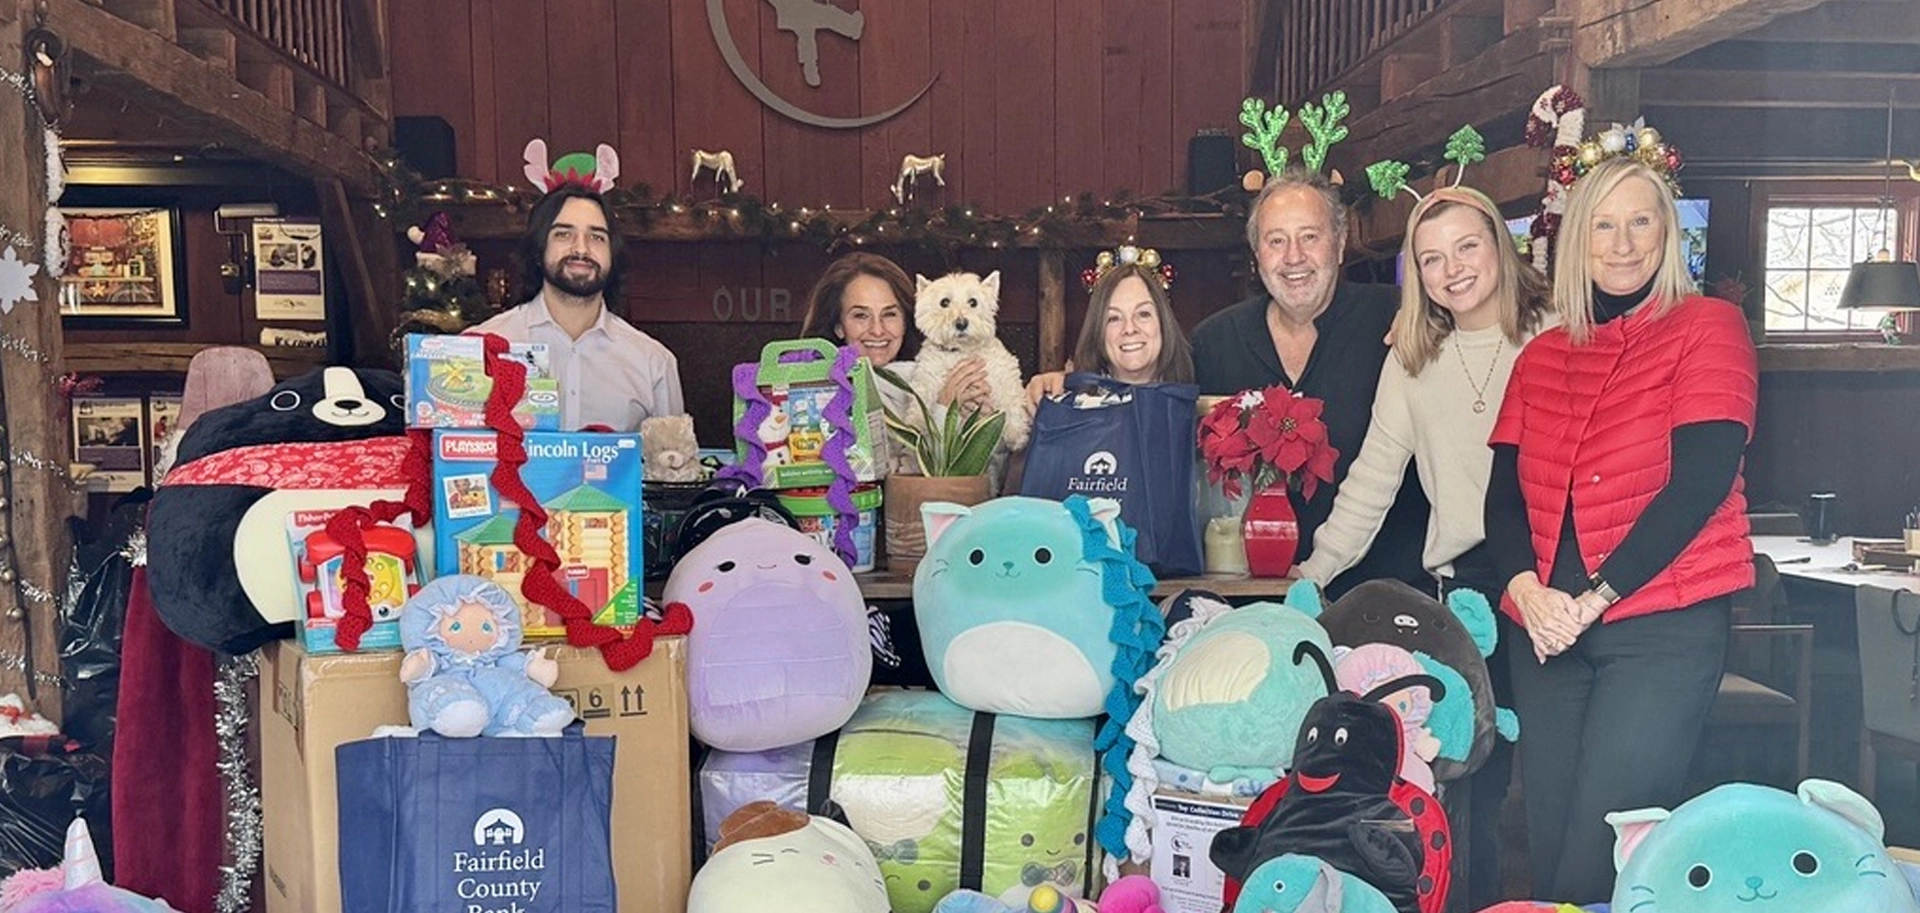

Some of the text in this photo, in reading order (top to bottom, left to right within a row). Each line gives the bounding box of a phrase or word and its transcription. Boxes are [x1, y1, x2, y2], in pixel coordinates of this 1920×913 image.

[712, 286, 792, 322] OUR
[444, 439, 498, 454] PLAYSKO
[528, 439, 619, 464] incoln Logs
[1067, 477, 1129, 491] Fairfield
[588, 687, 603, 708] 6
[1222, 810, 1240, 819] Drive
[453, 849, 545, 873] Fairfield
[457, 878, 541, 902] County
